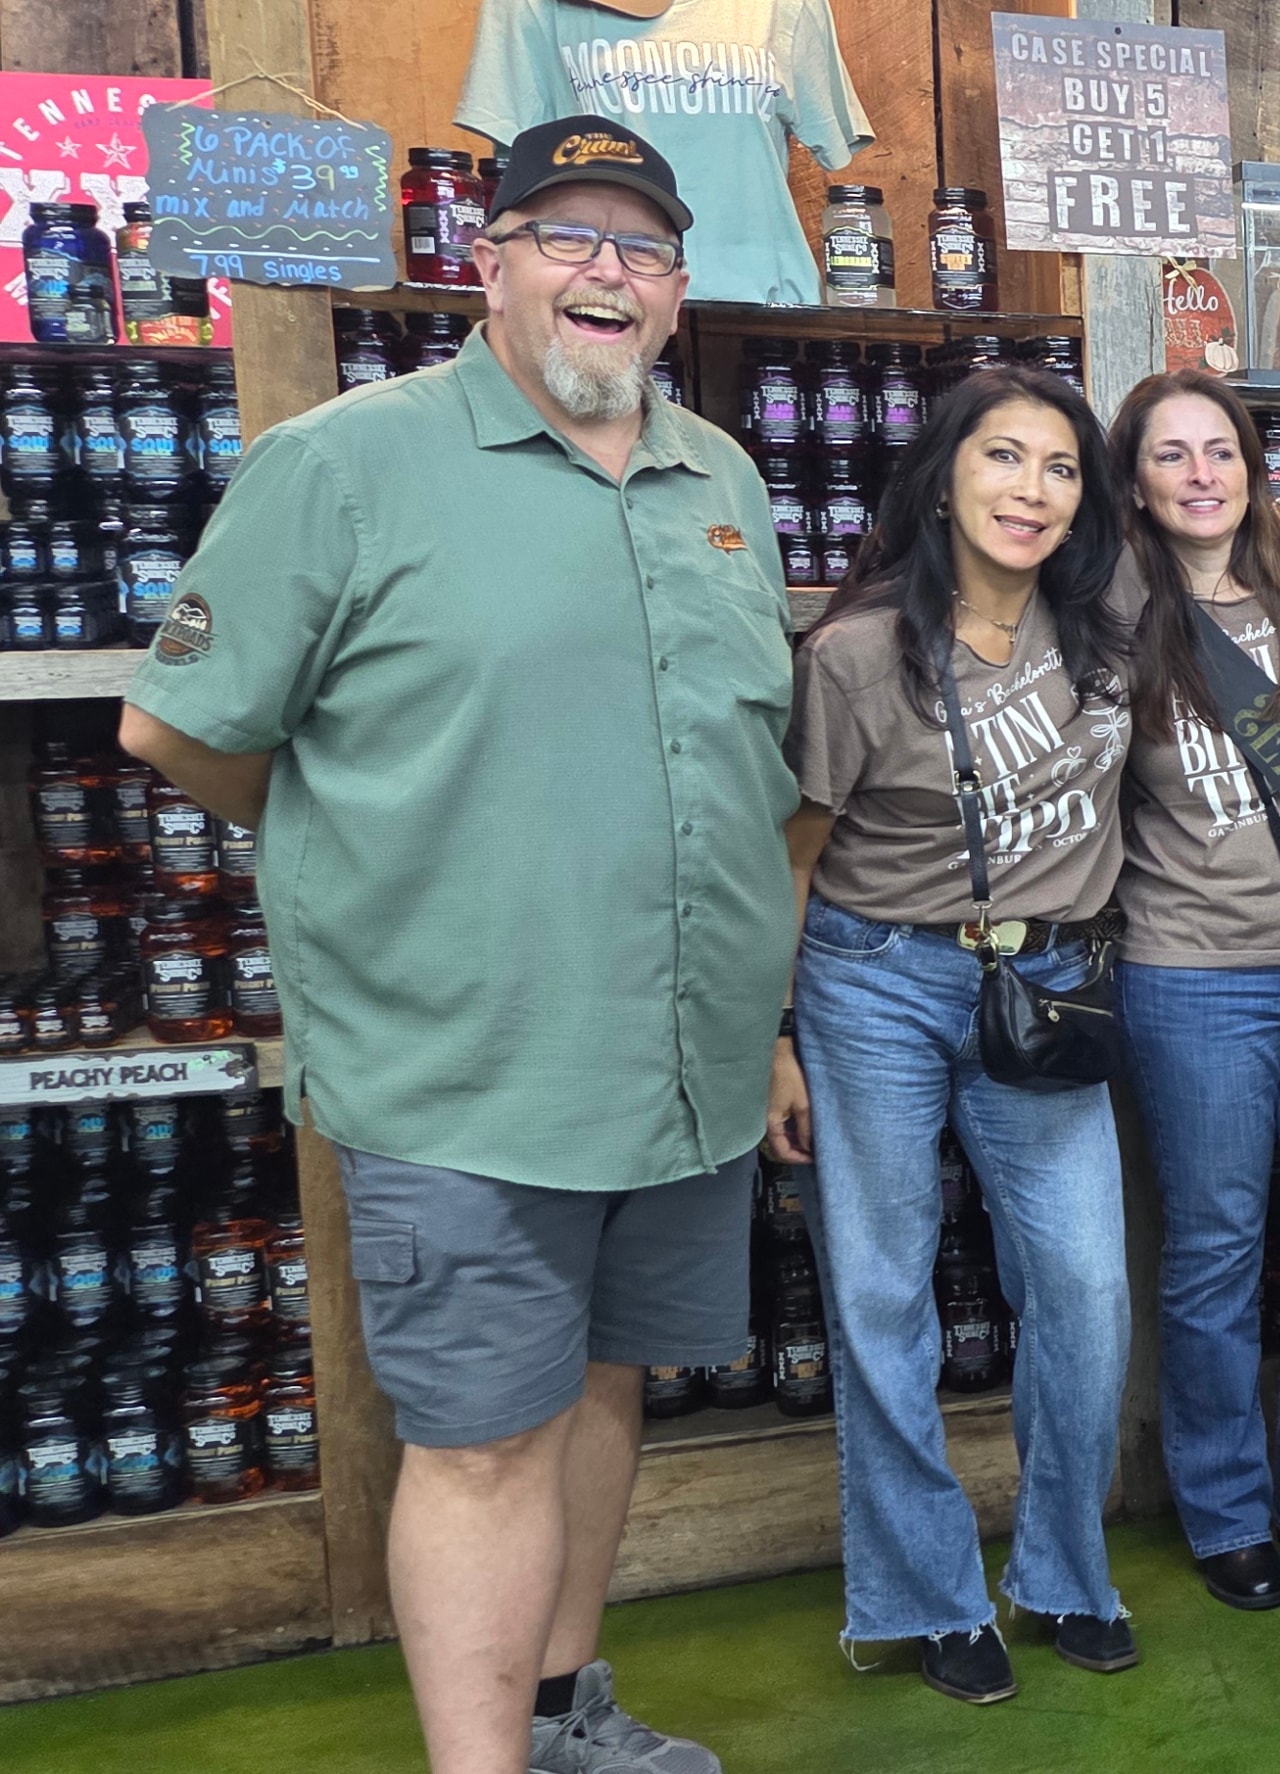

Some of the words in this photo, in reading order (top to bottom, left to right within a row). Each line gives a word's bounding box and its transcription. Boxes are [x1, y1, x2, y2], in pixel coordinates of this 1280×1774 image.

[1011, 33, 1084, 66] CASE
[1097, 41, 1211, 78] SPECIAL
[562, 39, 778, 123] MOONSHINE
[570, 68, 683, 102] tennessee
[689, 60, 763, 95] shine
[1063, 77, 1130, 115] BUY
[1146, 84, 1166, 116] 5
[195, 127, 218, 152] 6
[224, 127, 308, 158] PACK
[1072, 123, 1134, 160] GET
[1150, 130, 1165, 162] 1
[187, 158, 276, 185] Minis
[155, 193, 210, 218] mix
[227, 197, 264, 217] and
[1054, 174, 1191, 233] FREE
[190, 254, 244, 279] 7.99
[30, 1067, 113, 1090] PEACHY
[120, 1063, 188, 1084] PEACH
